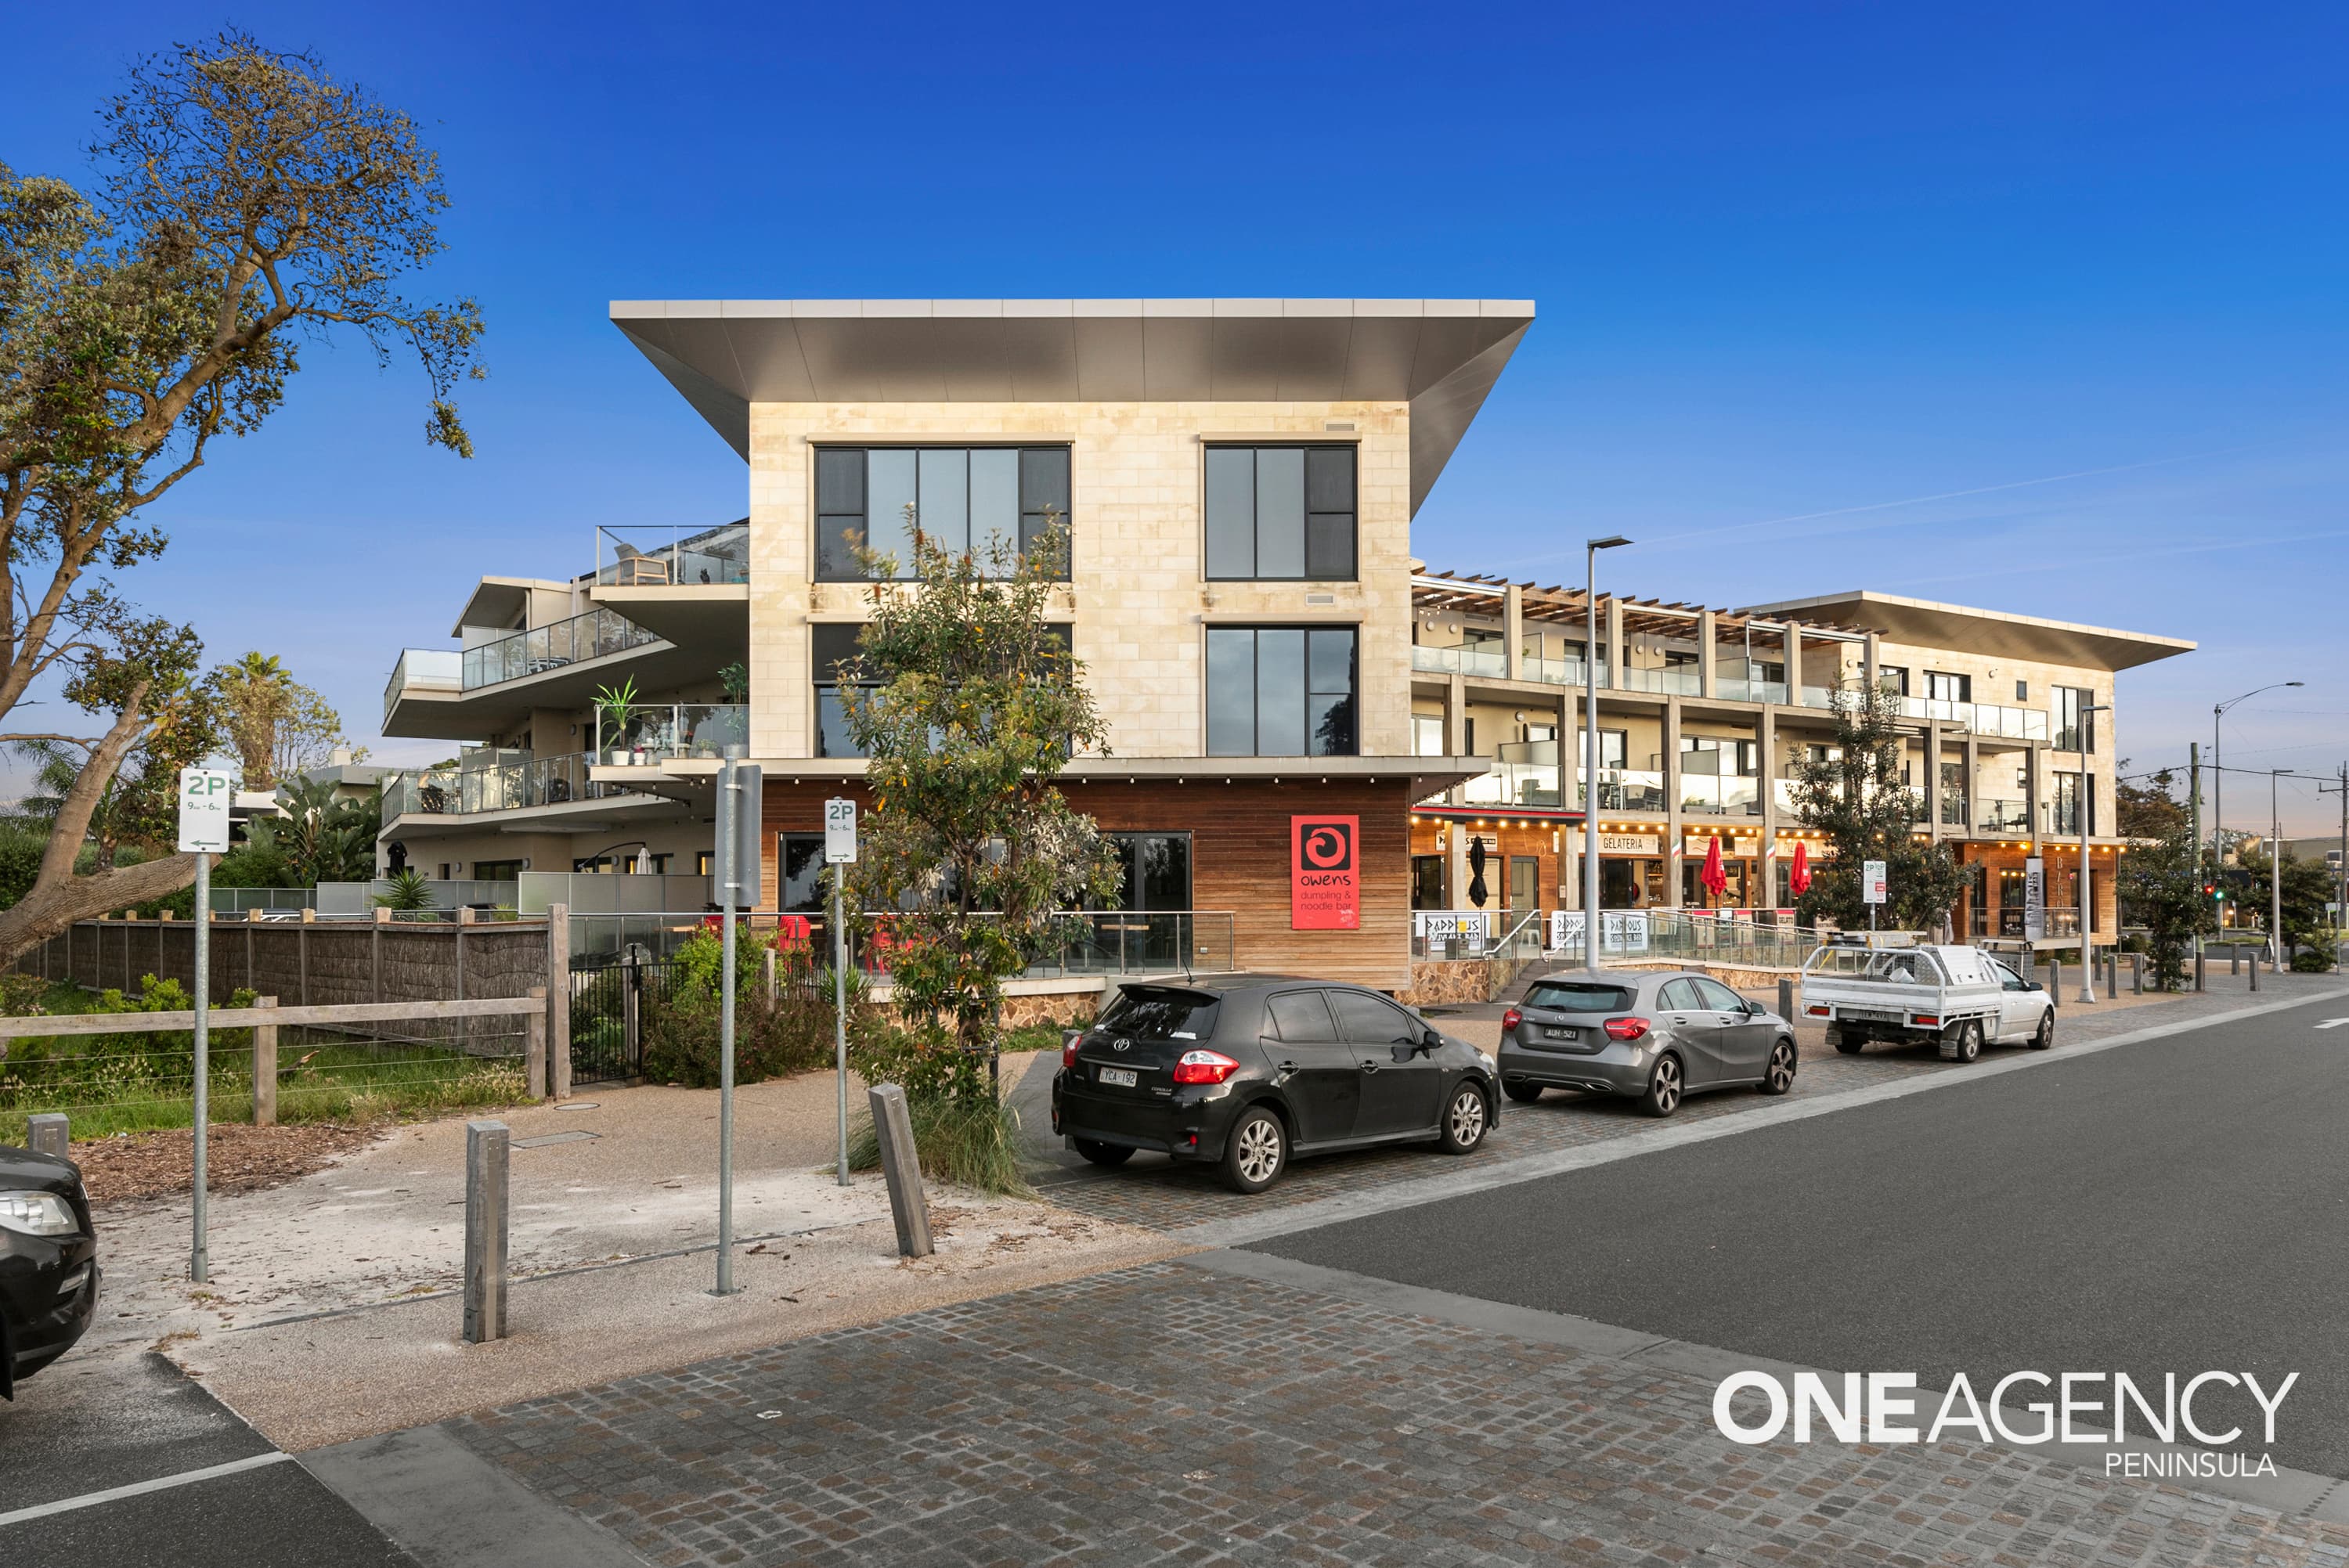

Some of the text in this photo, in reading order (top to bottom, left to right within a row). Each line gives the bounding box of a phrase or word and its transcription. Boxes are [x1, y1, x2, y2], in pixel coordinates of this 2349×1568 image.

[188, 776, 226, 795] 2P
[829, 805, 853, 820] 2P
[1603, 838, 1643, 849] GELATERIA
[1301, 874, 1351, 886] owens
[1301, 890, 1341, 901] dumpling
[1301, 901, 1352, 910] noodle bar
[1427, 919, 1479, 932] PAPPUS
